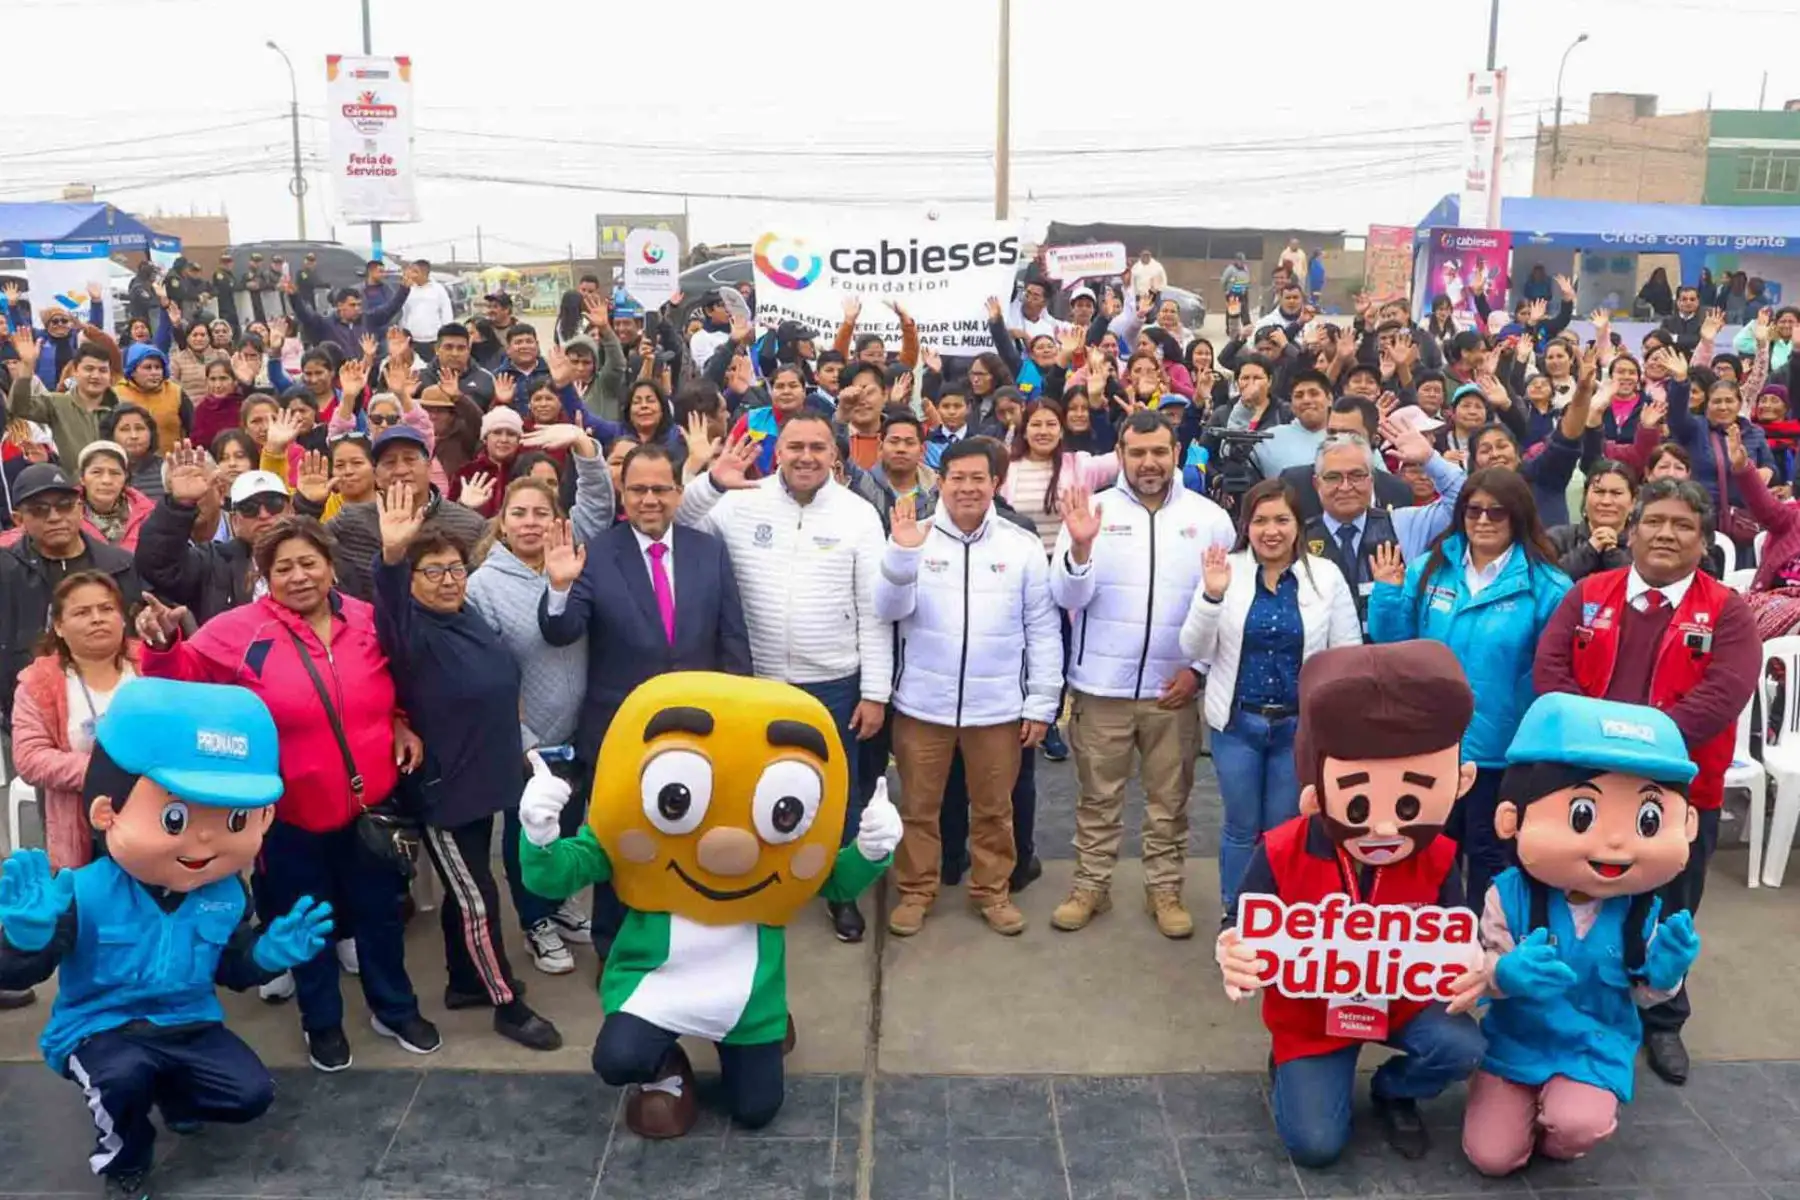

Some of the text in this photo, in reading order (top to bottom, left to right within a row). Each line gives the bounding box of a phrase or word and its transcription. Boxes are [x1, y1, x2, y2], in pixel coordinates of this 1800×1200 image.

[349, 153, 393, 164] Feria de
[346, 166, 398, 176] Servicios
[1600, 232, 1787, 250] Crece con su gente
[829, 236, 1019, 276] cabieses
[830, 277, 949, 293] Foundation
[781, 307, 832, 329] PELOTA
[952, 320, 978, 332] UNA
[942, 335, 958, 346] EL
[1242, 898, 1473, 944] Defensa
